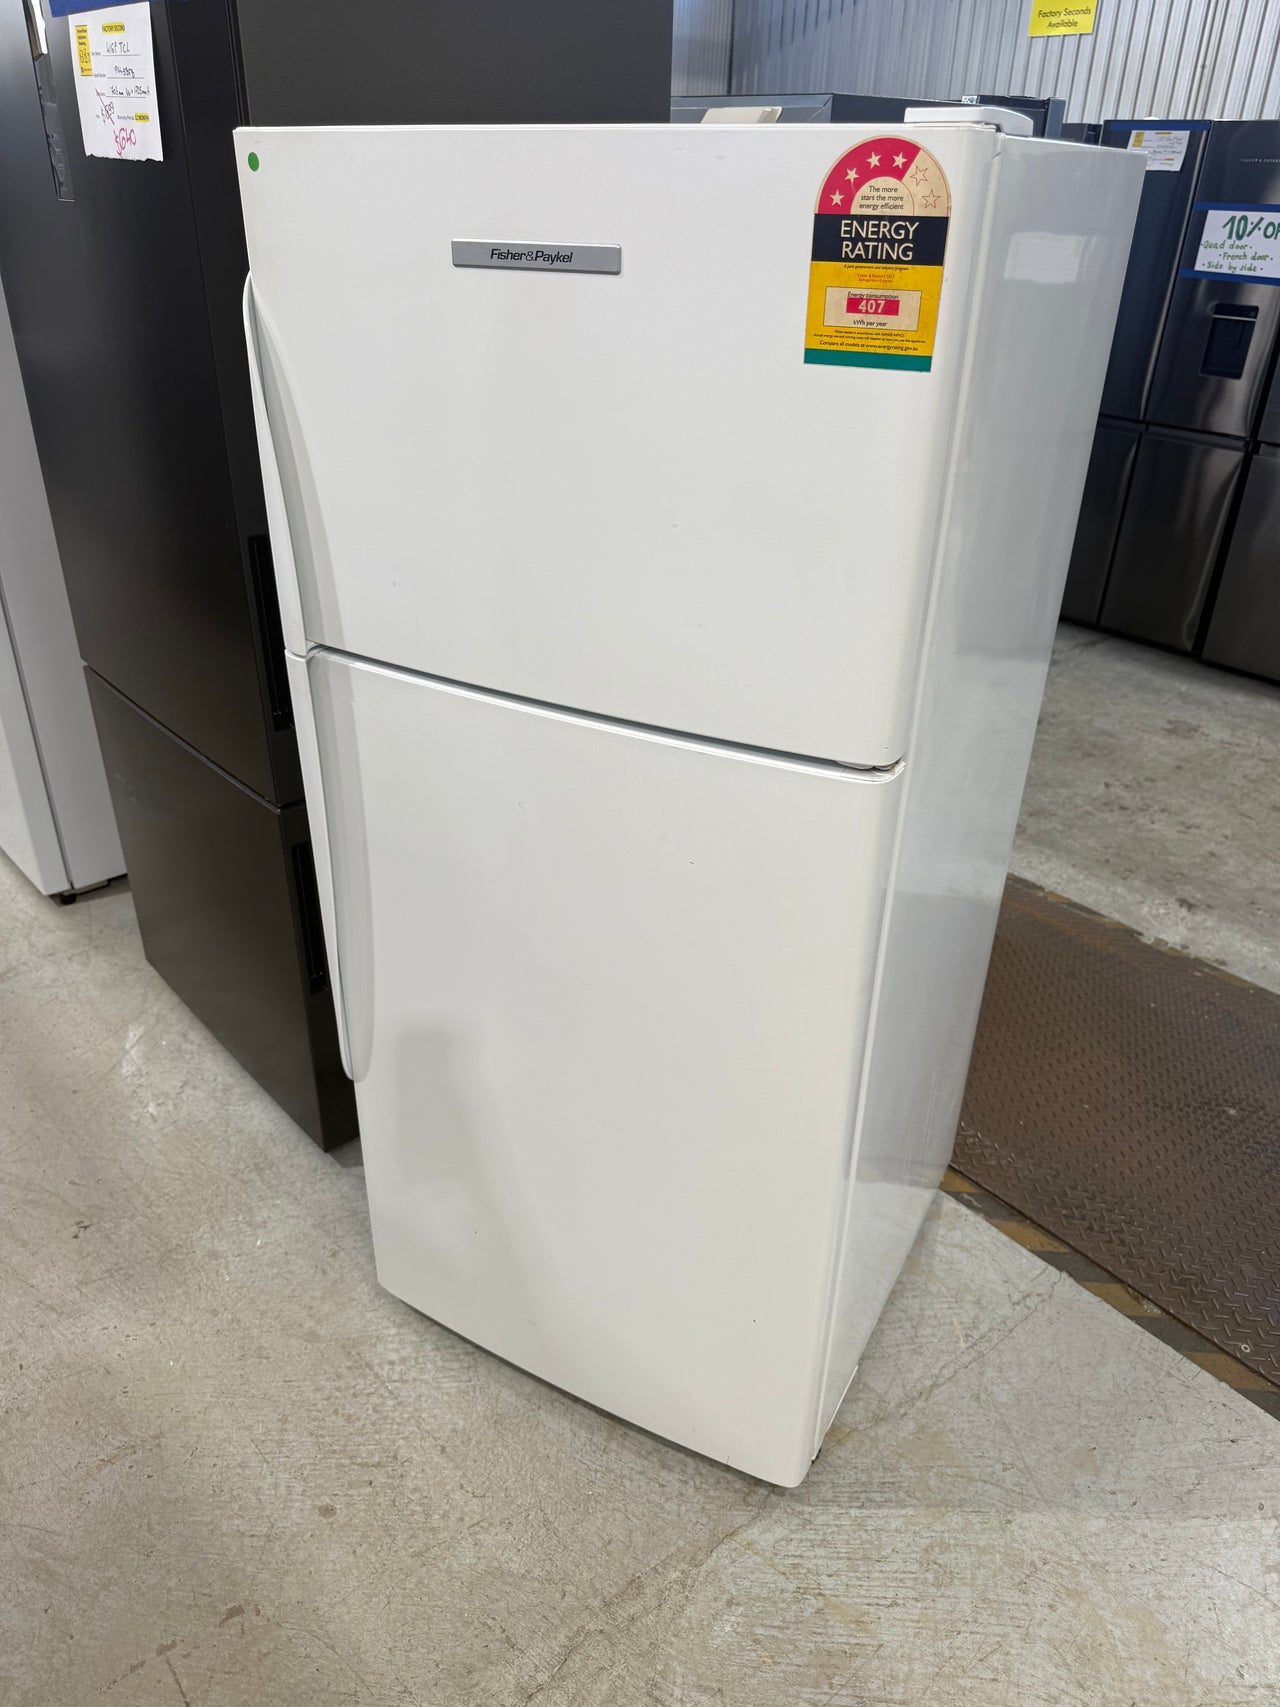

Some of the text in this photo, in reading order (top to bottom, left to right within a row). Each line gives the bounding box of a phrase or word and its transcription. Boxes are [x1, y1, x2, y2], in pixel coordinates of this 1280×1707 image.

[1038, 6, 1092, 18] Factory Seconds
[1047, 19, 1078, 28] Available
[840, 220, 920, 239] ENERGY
[1222, 214, 1265, 241] 10%
[842, 241, 914, 260] RATING
[1203, 240, 1248, 249] Quad door
[490, 248, 573, 265] Fisher&Paykel
[1223, 251, 1269, 261] French door
[1207, 261, 1257, 273] Side by side
[858, 300, 886, 313] 407
